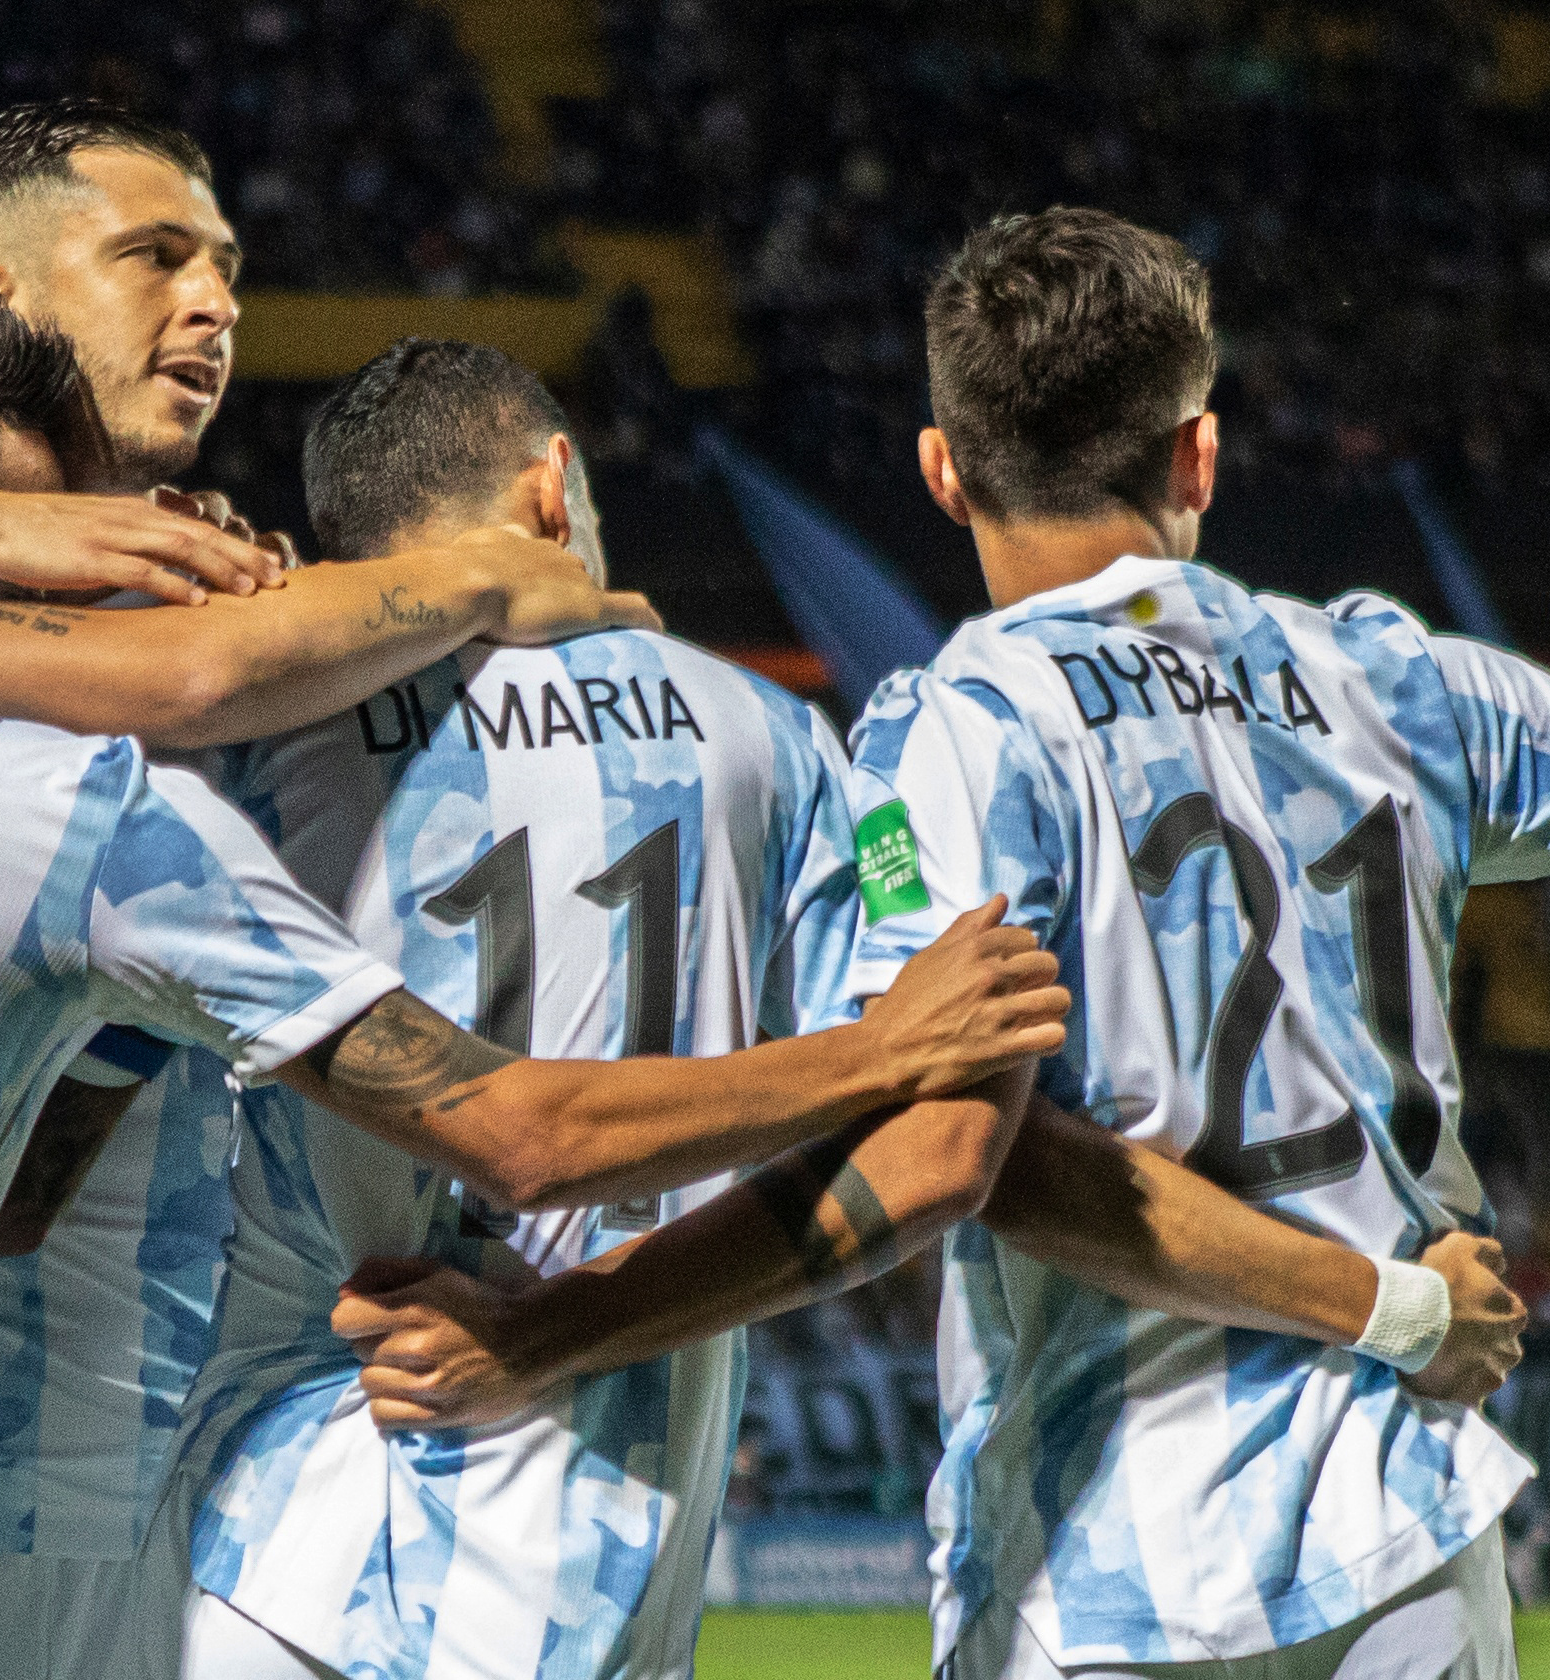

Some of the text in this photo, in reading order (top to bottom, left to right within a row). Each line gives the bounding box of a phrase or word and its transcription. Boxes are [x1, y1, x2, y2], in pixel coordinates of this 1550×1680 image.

[355, 675, 705, 755] DI MARIA
[1048, 643, 1332, 737] DYBALA
[884, 867, 916, 893] FIFA
[421, 818, 681, 1236] 11
[1129, 791, 1442, 1193] 21
